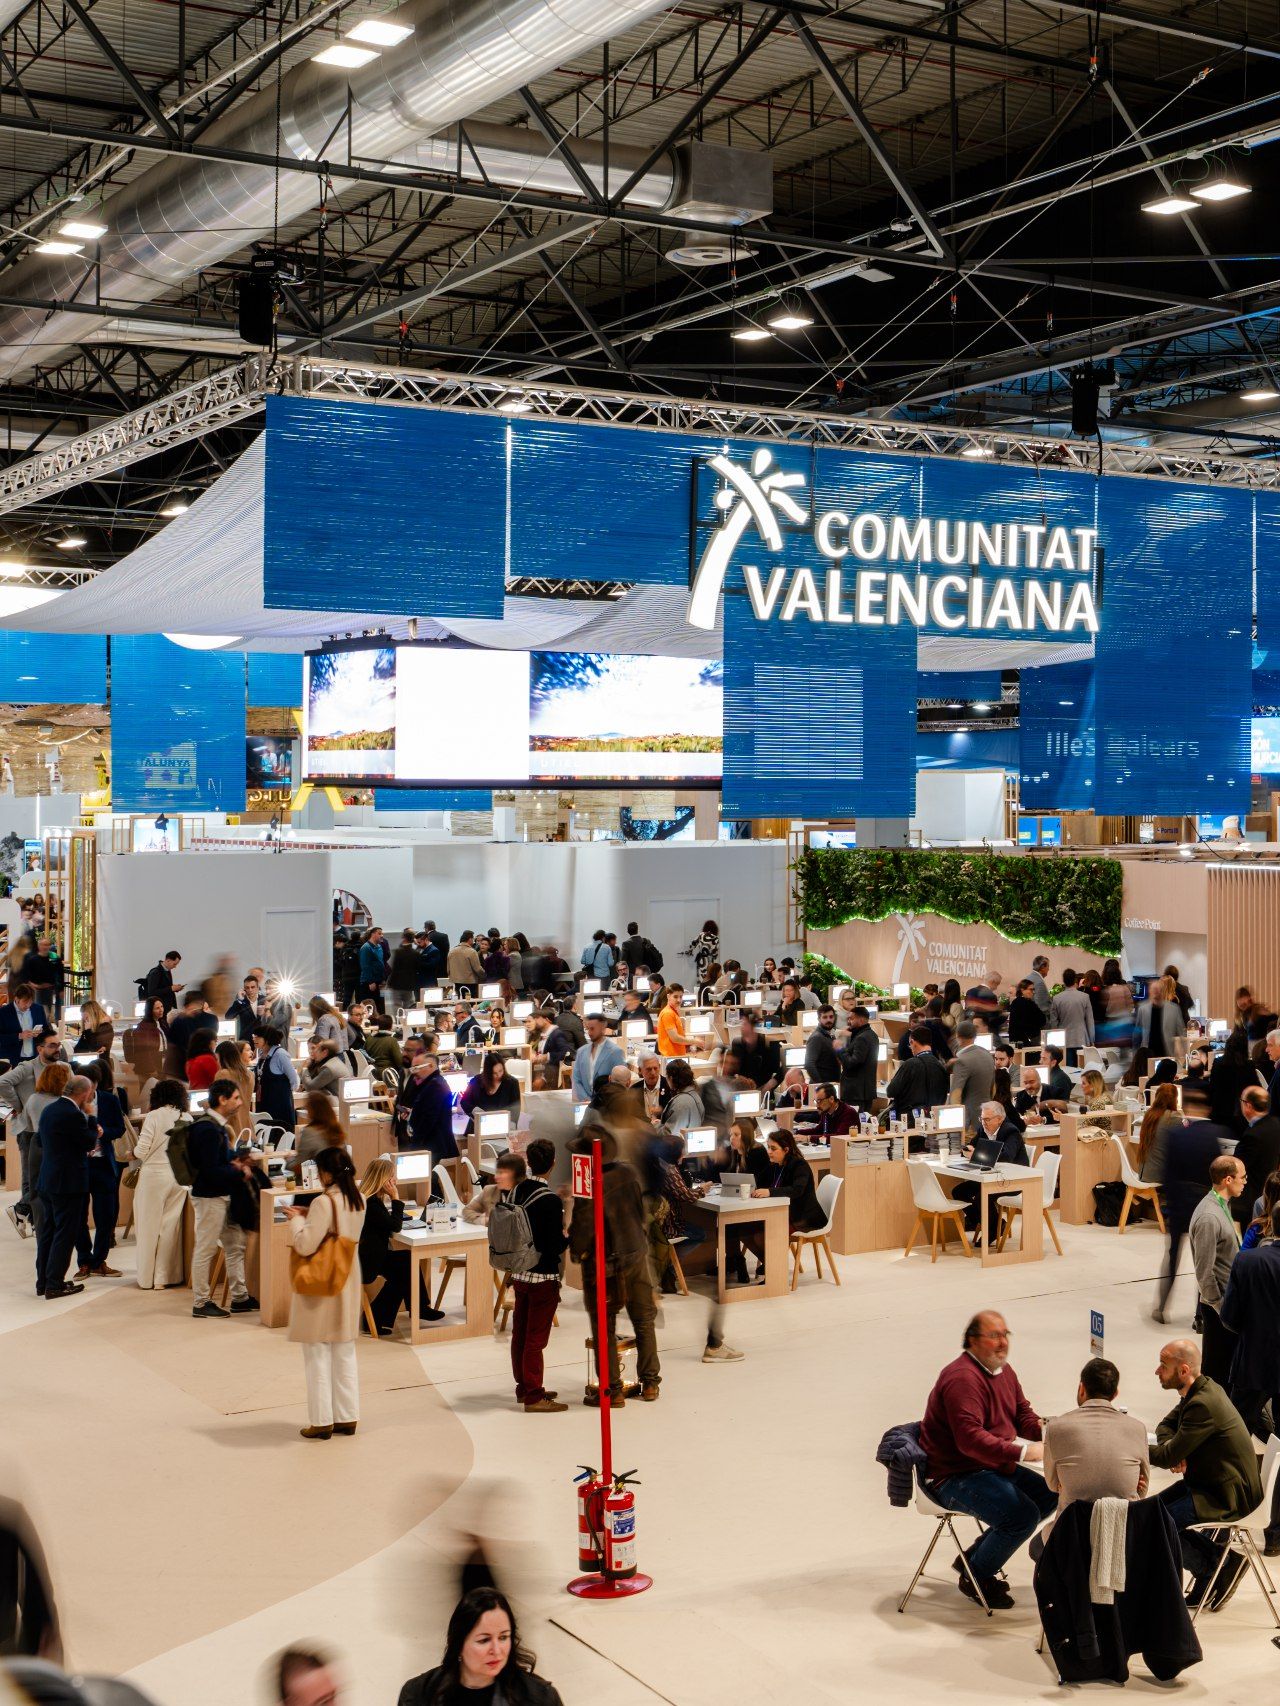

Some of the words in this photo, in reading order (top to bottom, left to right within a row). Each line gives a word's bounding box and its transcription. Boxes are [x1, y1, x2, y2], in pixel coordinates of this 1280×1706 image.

[815, 511, 1099, 571] COMUNITAT
[742, 565, 1100, 633] VALENCIANA
[928, 942, 988, 961] COMUNITAT
[925, 958, 988, 979] VALENCIANA
[1092, 1314, 1102, 1334] 05
